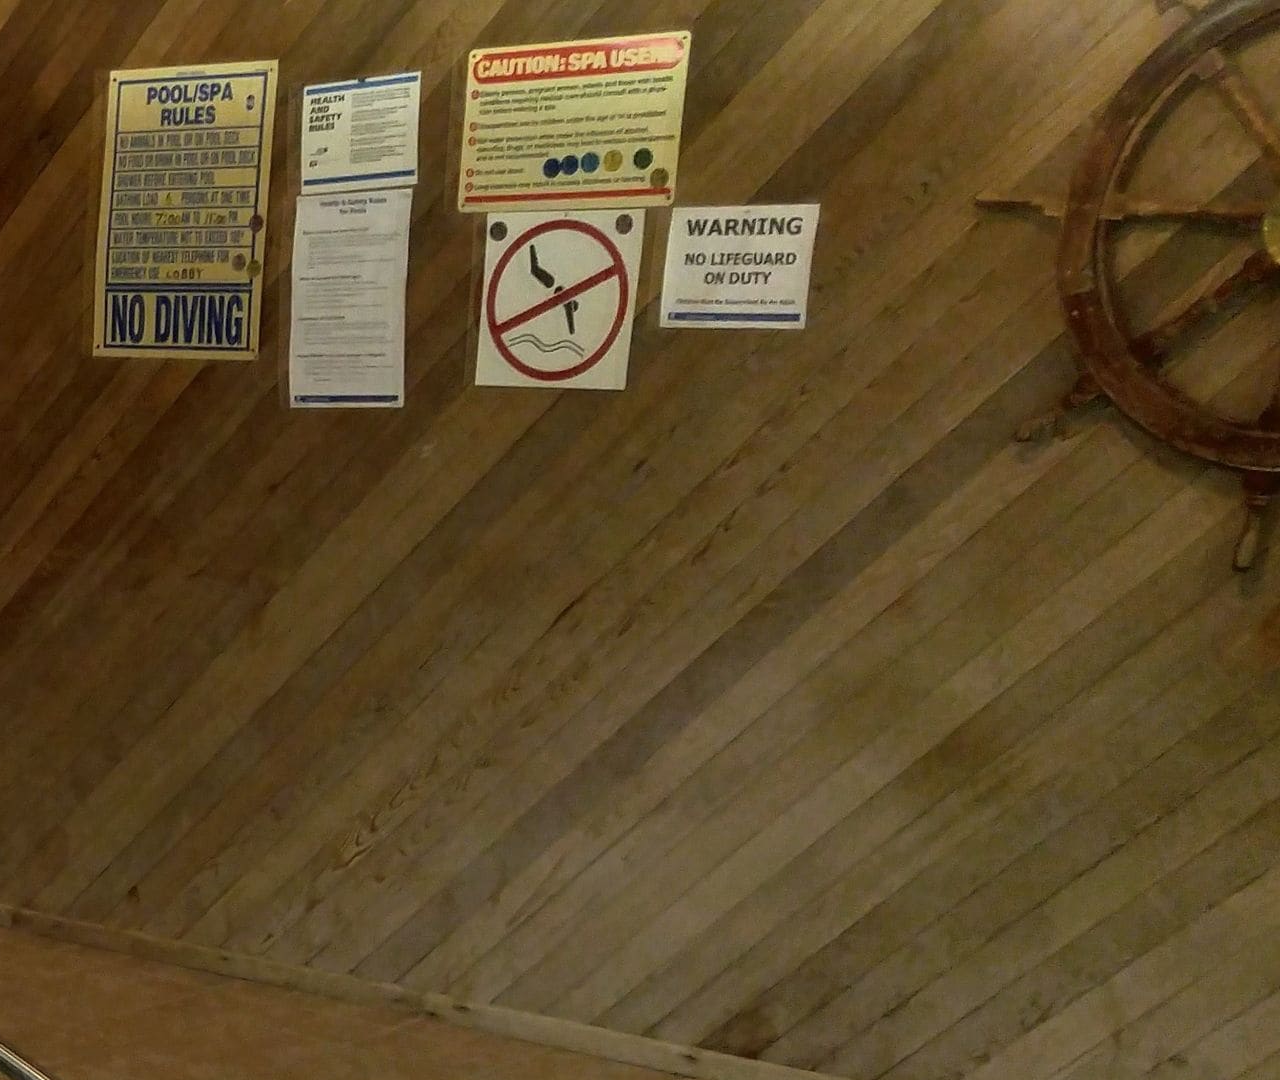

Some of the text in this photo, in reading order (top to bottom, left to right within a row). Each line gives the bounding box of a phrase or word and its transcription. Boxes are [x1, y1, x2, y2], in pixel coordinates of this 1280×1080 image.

[477, 54, 567, 77] CAUTION:
[568, 50, 607, 71] SPA
[146, 82, 233, 105] POOL/SPA
[310, 94, 345, 105] HEALTH
[160, 105, 216, 127] RULES
[310, 105, 329, 114] AND
[309, 112, 342, 124] SAFETY
[309, 123, 335, 132] RULES
[687, 216, 803, 236] WARNING
[684, 252, 797, 266] NO LIFEGUARD
[704, 271, 772, 285] ON DUTY
[111, 294, 145, 344] NO
[154, 294, 244, 345] DIVING
